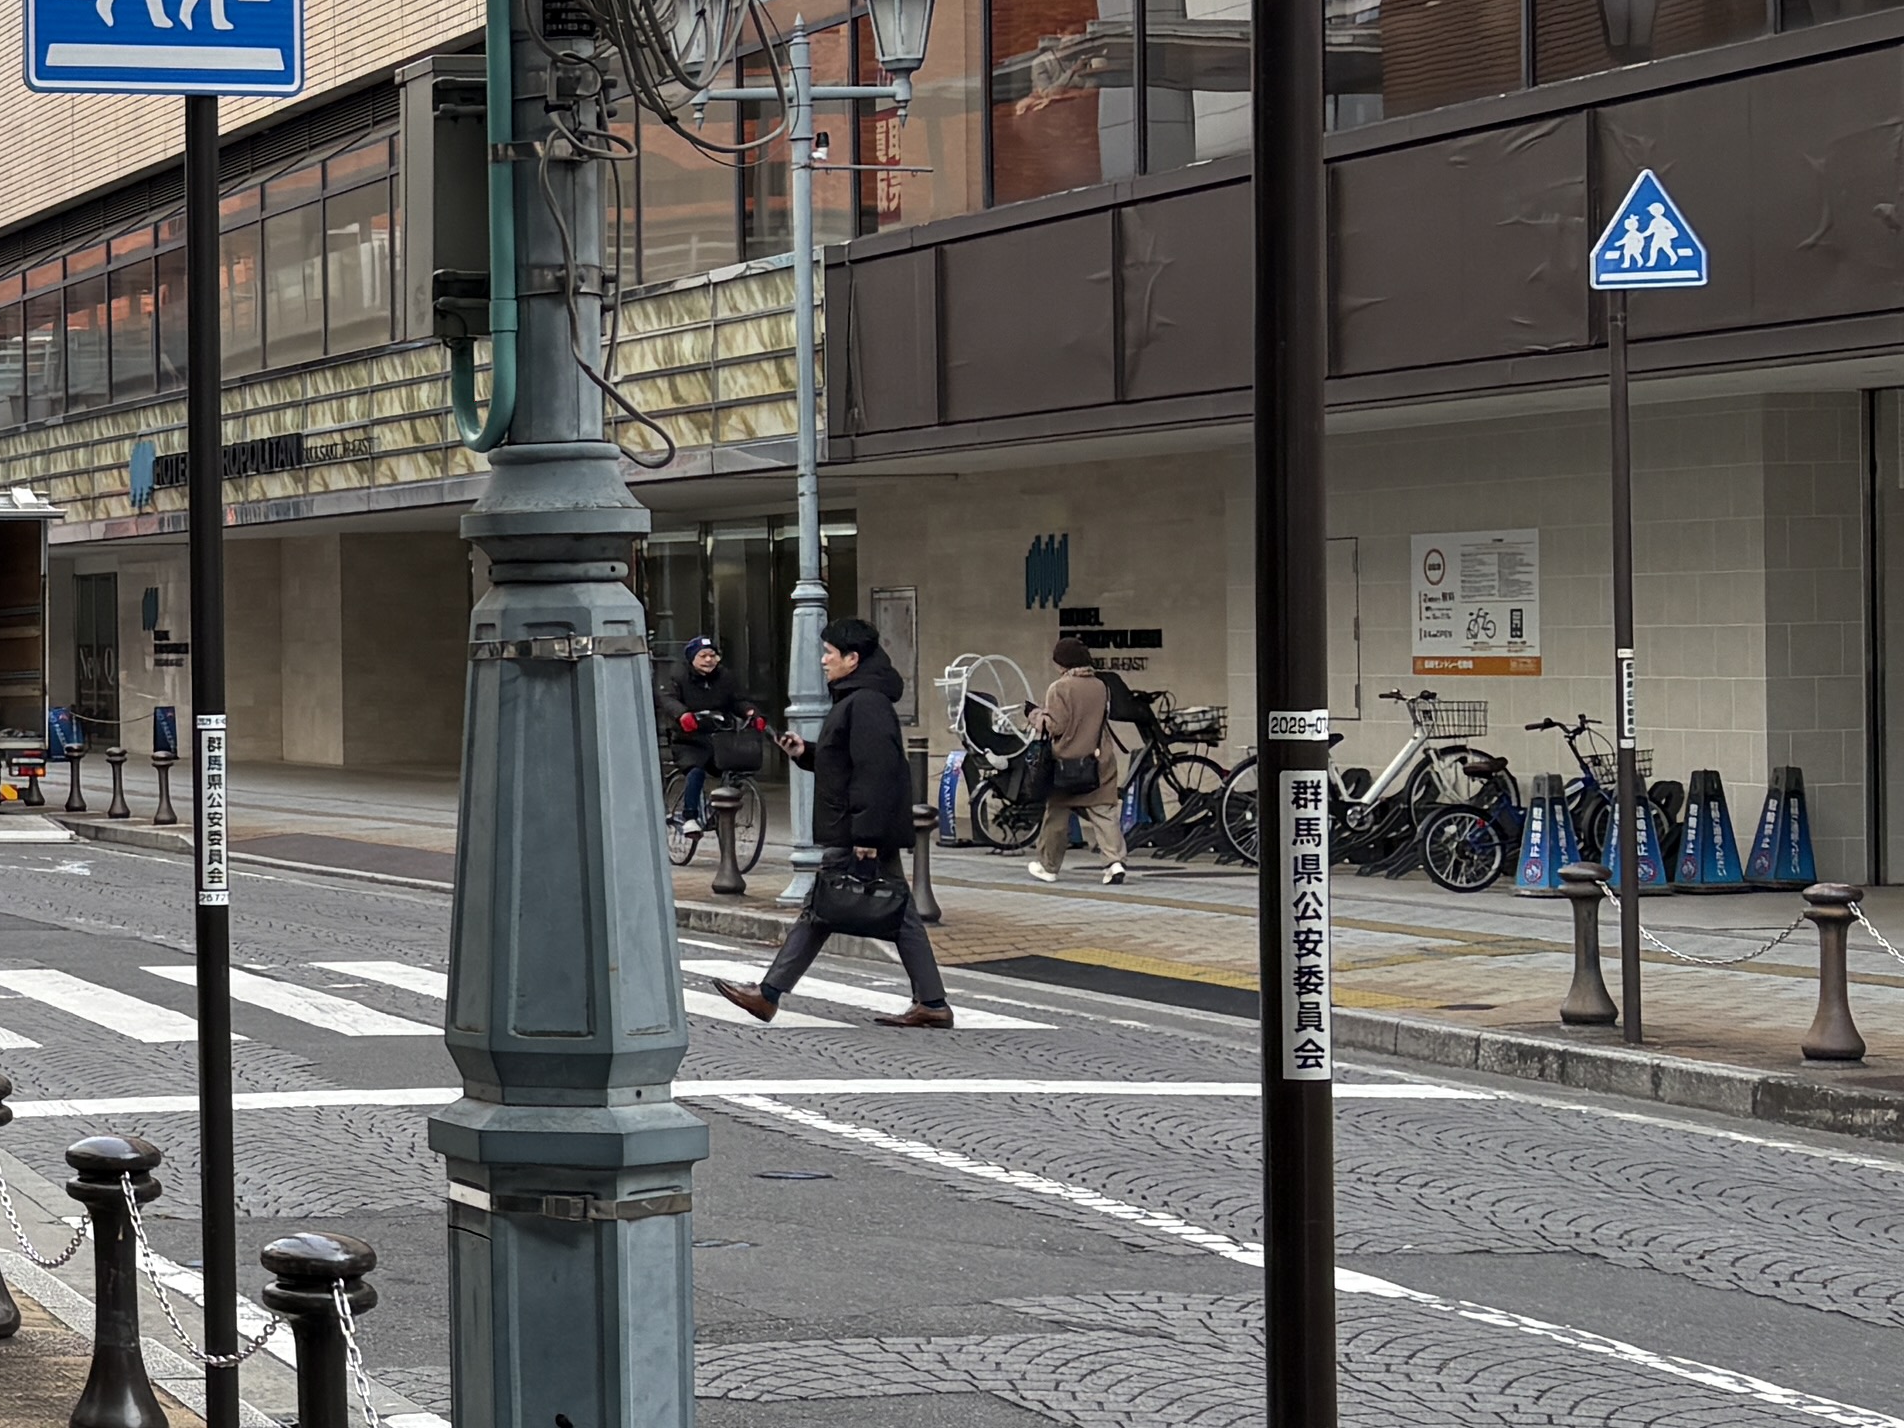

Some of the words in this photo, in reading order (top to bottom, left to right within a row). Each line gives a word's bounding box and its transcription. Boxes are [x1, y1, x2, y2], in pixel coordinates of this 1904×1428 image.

[154, 453, 190, 487] HOTE
[223, 433, 303, 476] ROPOLITAN
[206, 736, 223, 884] 群馬県公安委員会
[1290, 779, 1326, 1071] 群馬県公安委員会
